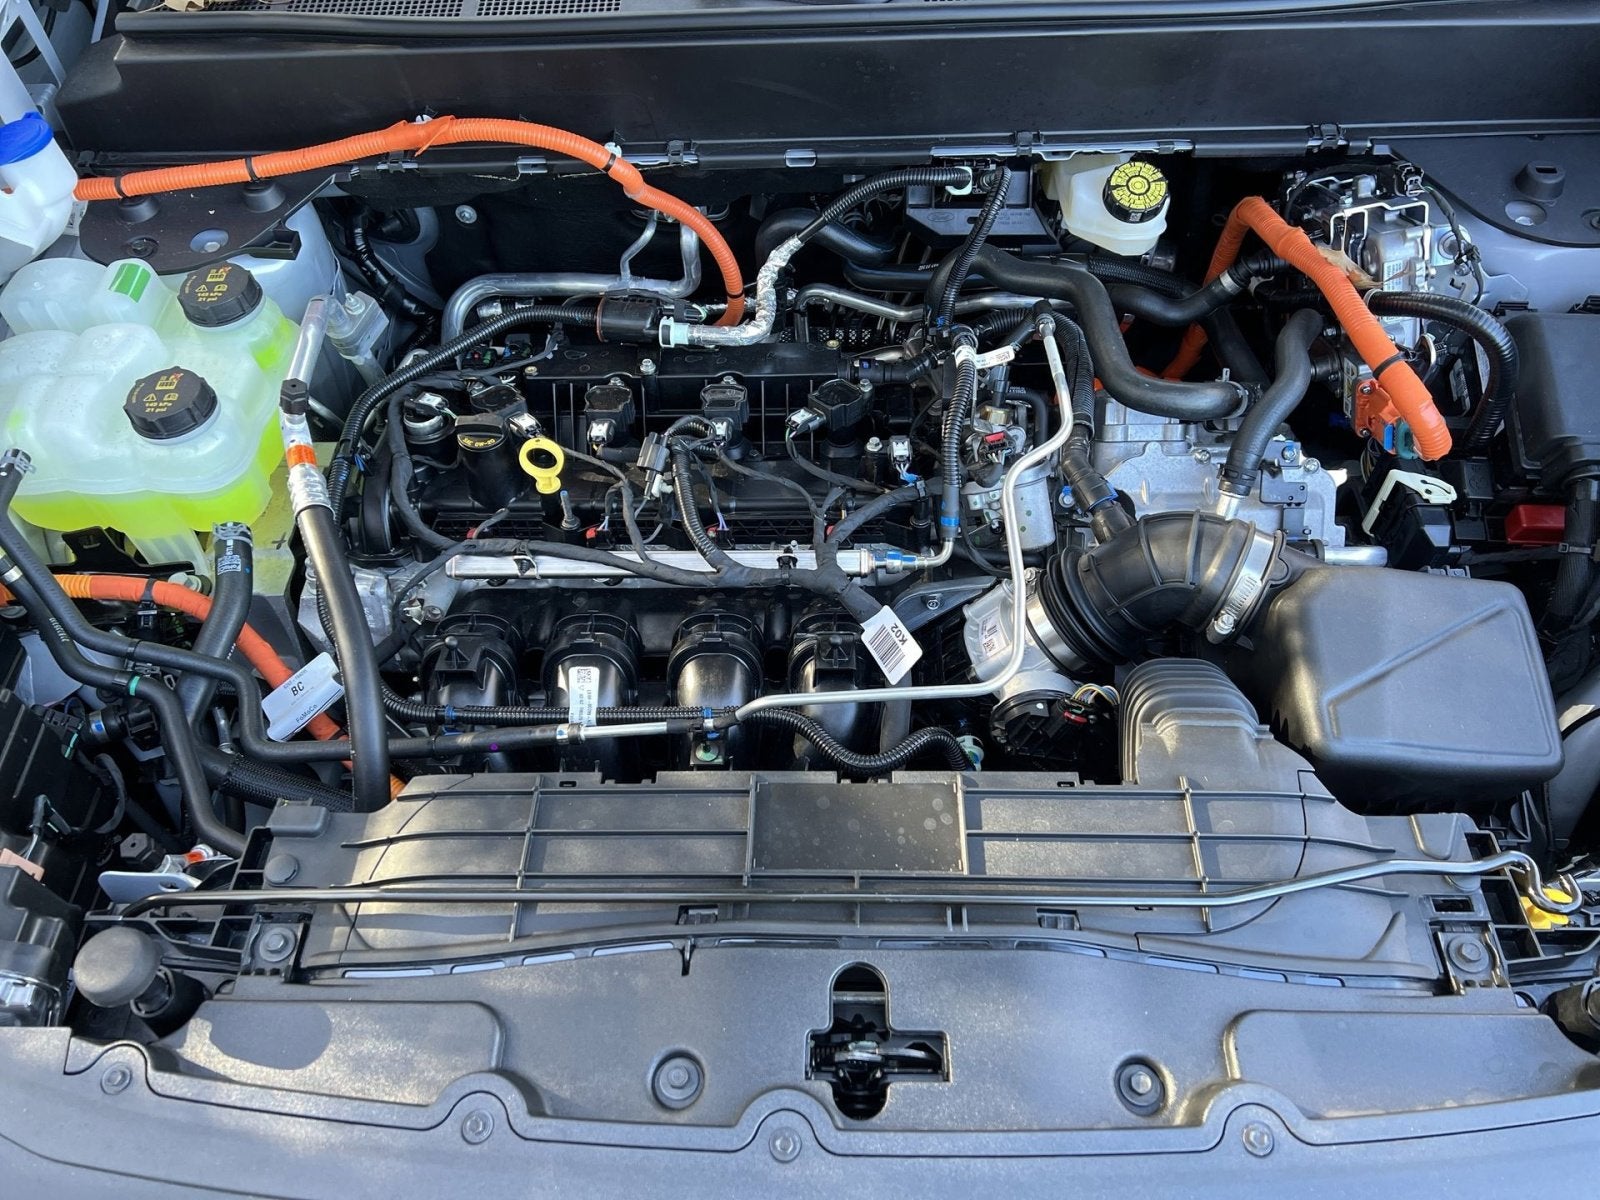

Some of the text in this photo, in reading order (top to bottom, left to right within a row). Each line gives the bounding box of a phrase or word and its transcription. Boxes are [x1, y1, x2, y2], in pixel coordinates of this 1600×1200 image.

[890, 623, 908, 646] K02
[291, 681, 305, 697] BC
[296, 704, 318, 723] FoMoCo
